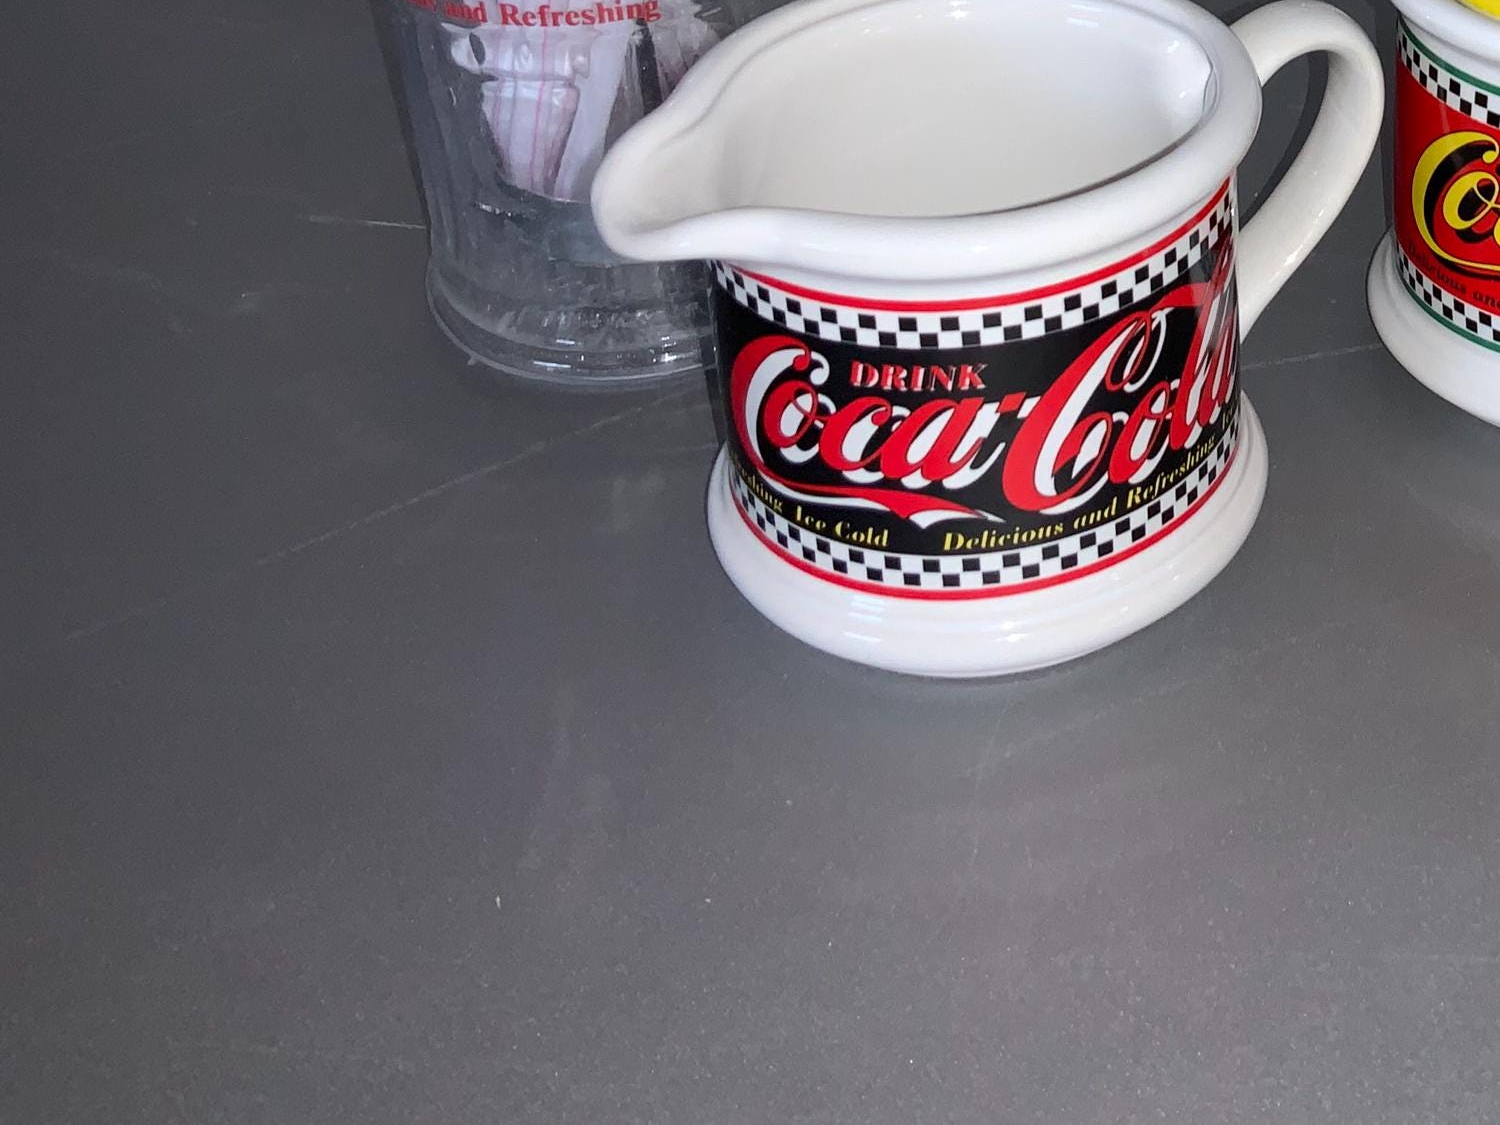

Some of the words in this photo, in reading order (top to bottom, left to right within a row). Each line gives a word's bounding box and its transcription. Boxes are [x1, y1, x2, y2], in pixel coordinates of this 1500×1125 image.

[848, 359, 988, 392] DRINK
[795, 504, 827, 531] Ice
[834, 521, 889, 548] Cold
[942, 520, 1065, 553] Delicious
[1072, 499, 1117, 529] and
[1126, 435, 1216, 510] Refreshing
